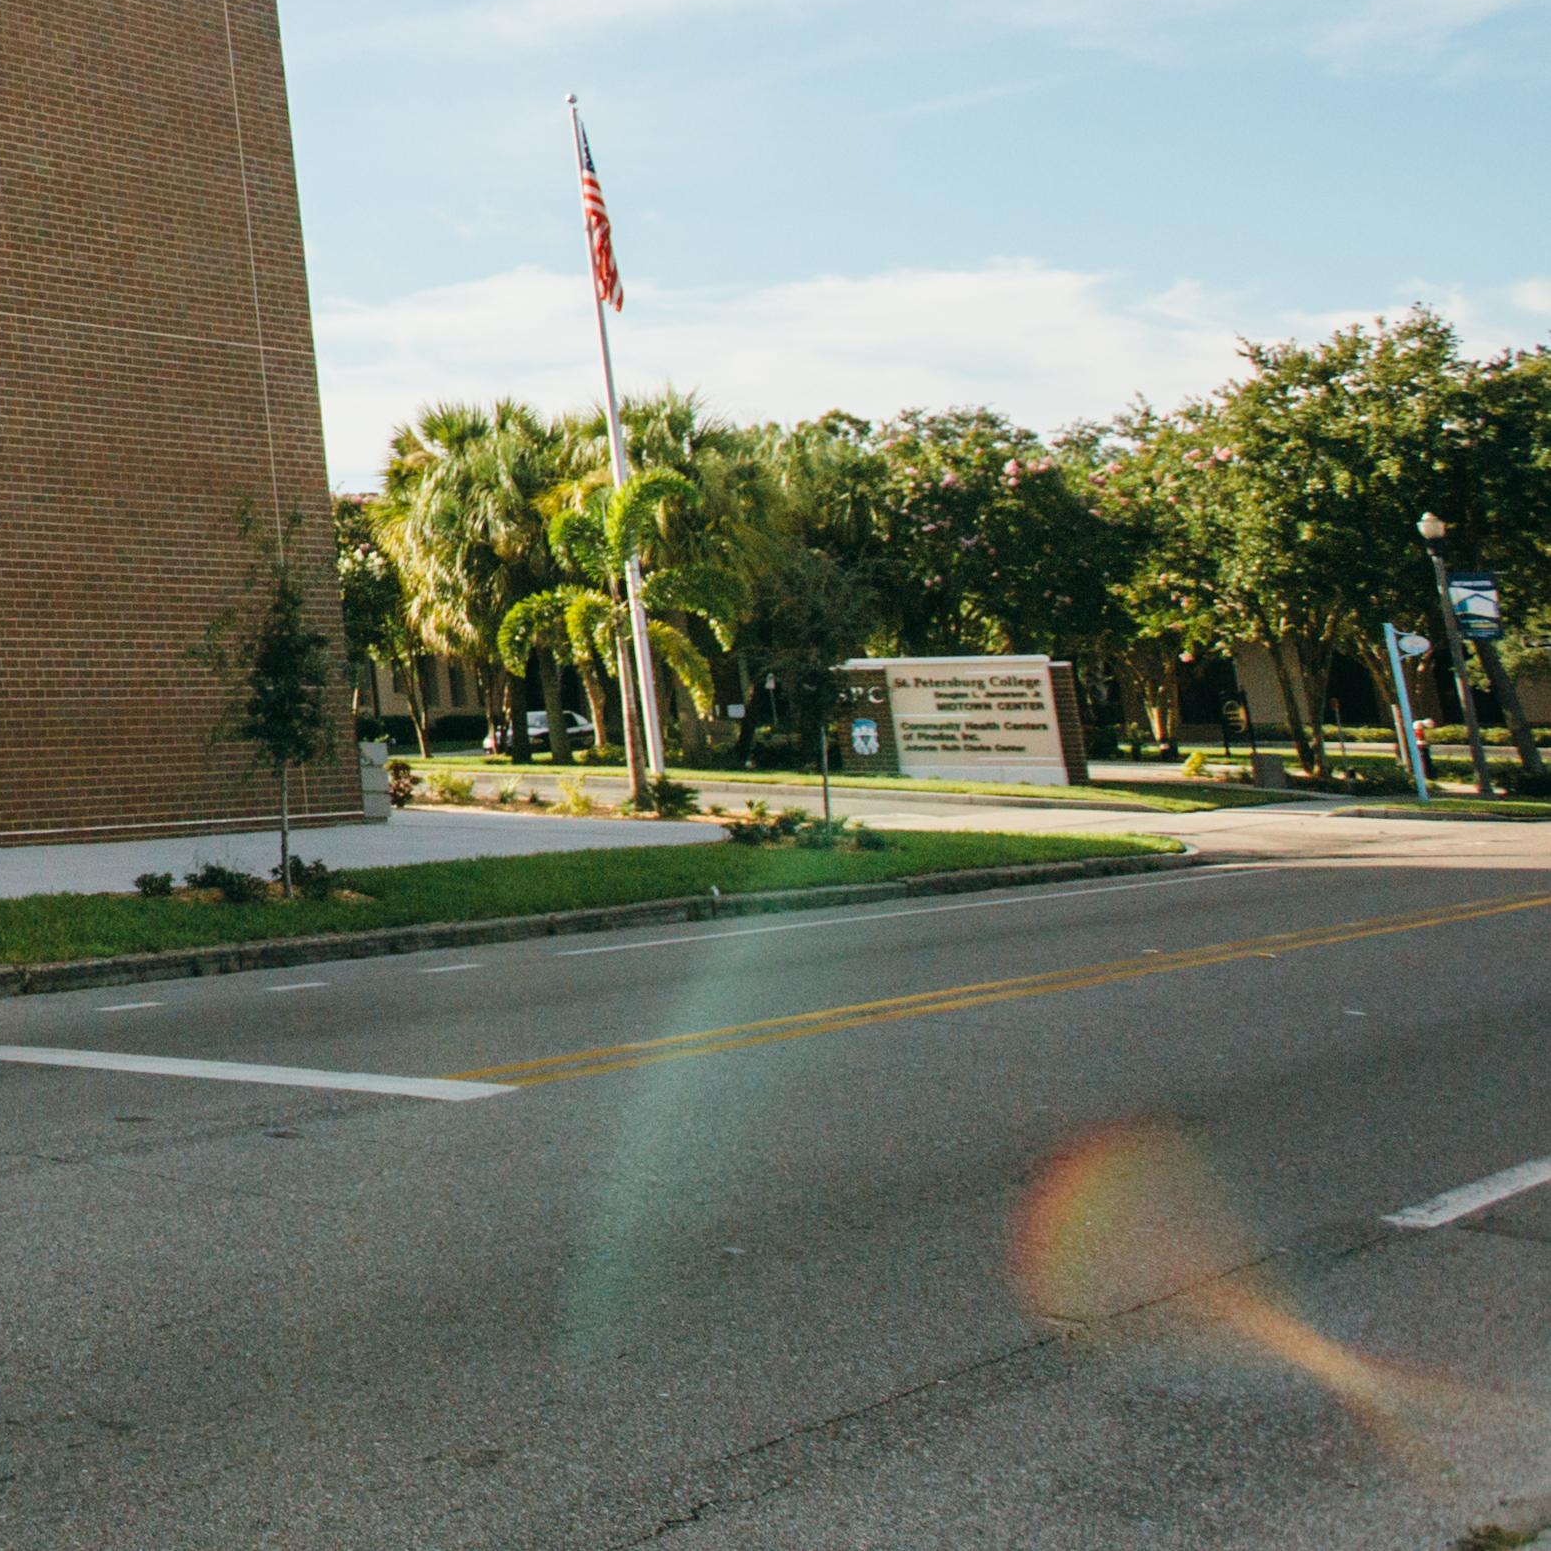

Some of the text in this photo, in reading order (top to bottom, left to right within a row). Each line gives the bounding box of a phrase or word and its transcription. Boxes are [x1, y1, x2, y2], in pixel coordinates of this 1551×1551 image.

[893, 675, 1041, 690] St. Petersburg College
[936, 700, 1046, 711] MIDTOWN CENTER
[900, 721, 1049, 732] Community Health Centers
[902, 733, 913, 741] of
